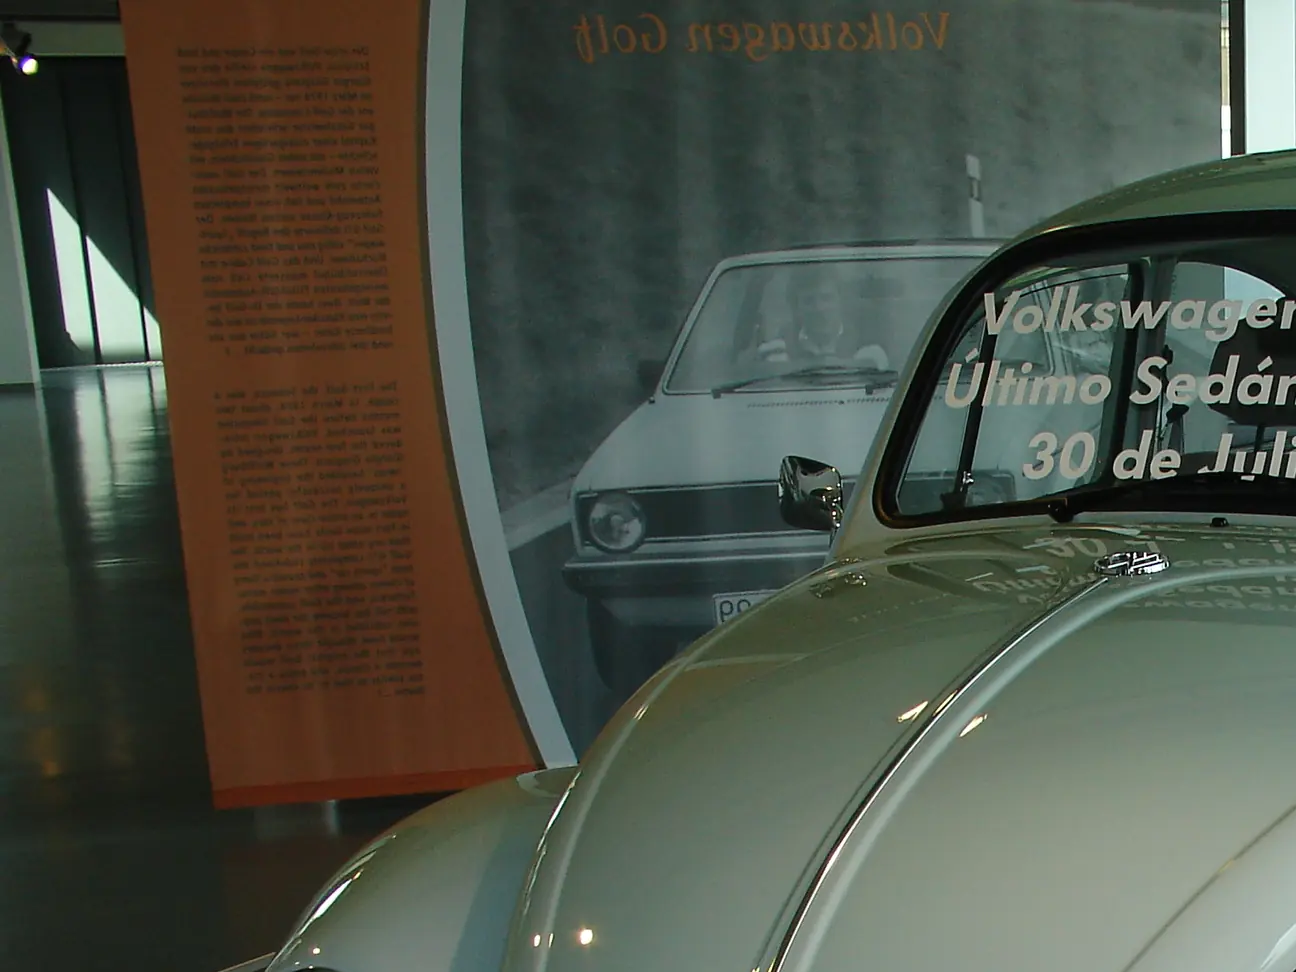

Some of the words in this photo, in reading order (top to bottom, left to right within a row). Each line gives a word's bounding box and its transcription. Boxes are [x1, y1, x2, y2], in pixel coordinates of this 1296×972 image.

[944, 347, 1113, 407] Último
[1022, 431, 1097, 480] 30
[1112, 430, 1182, 480] de
